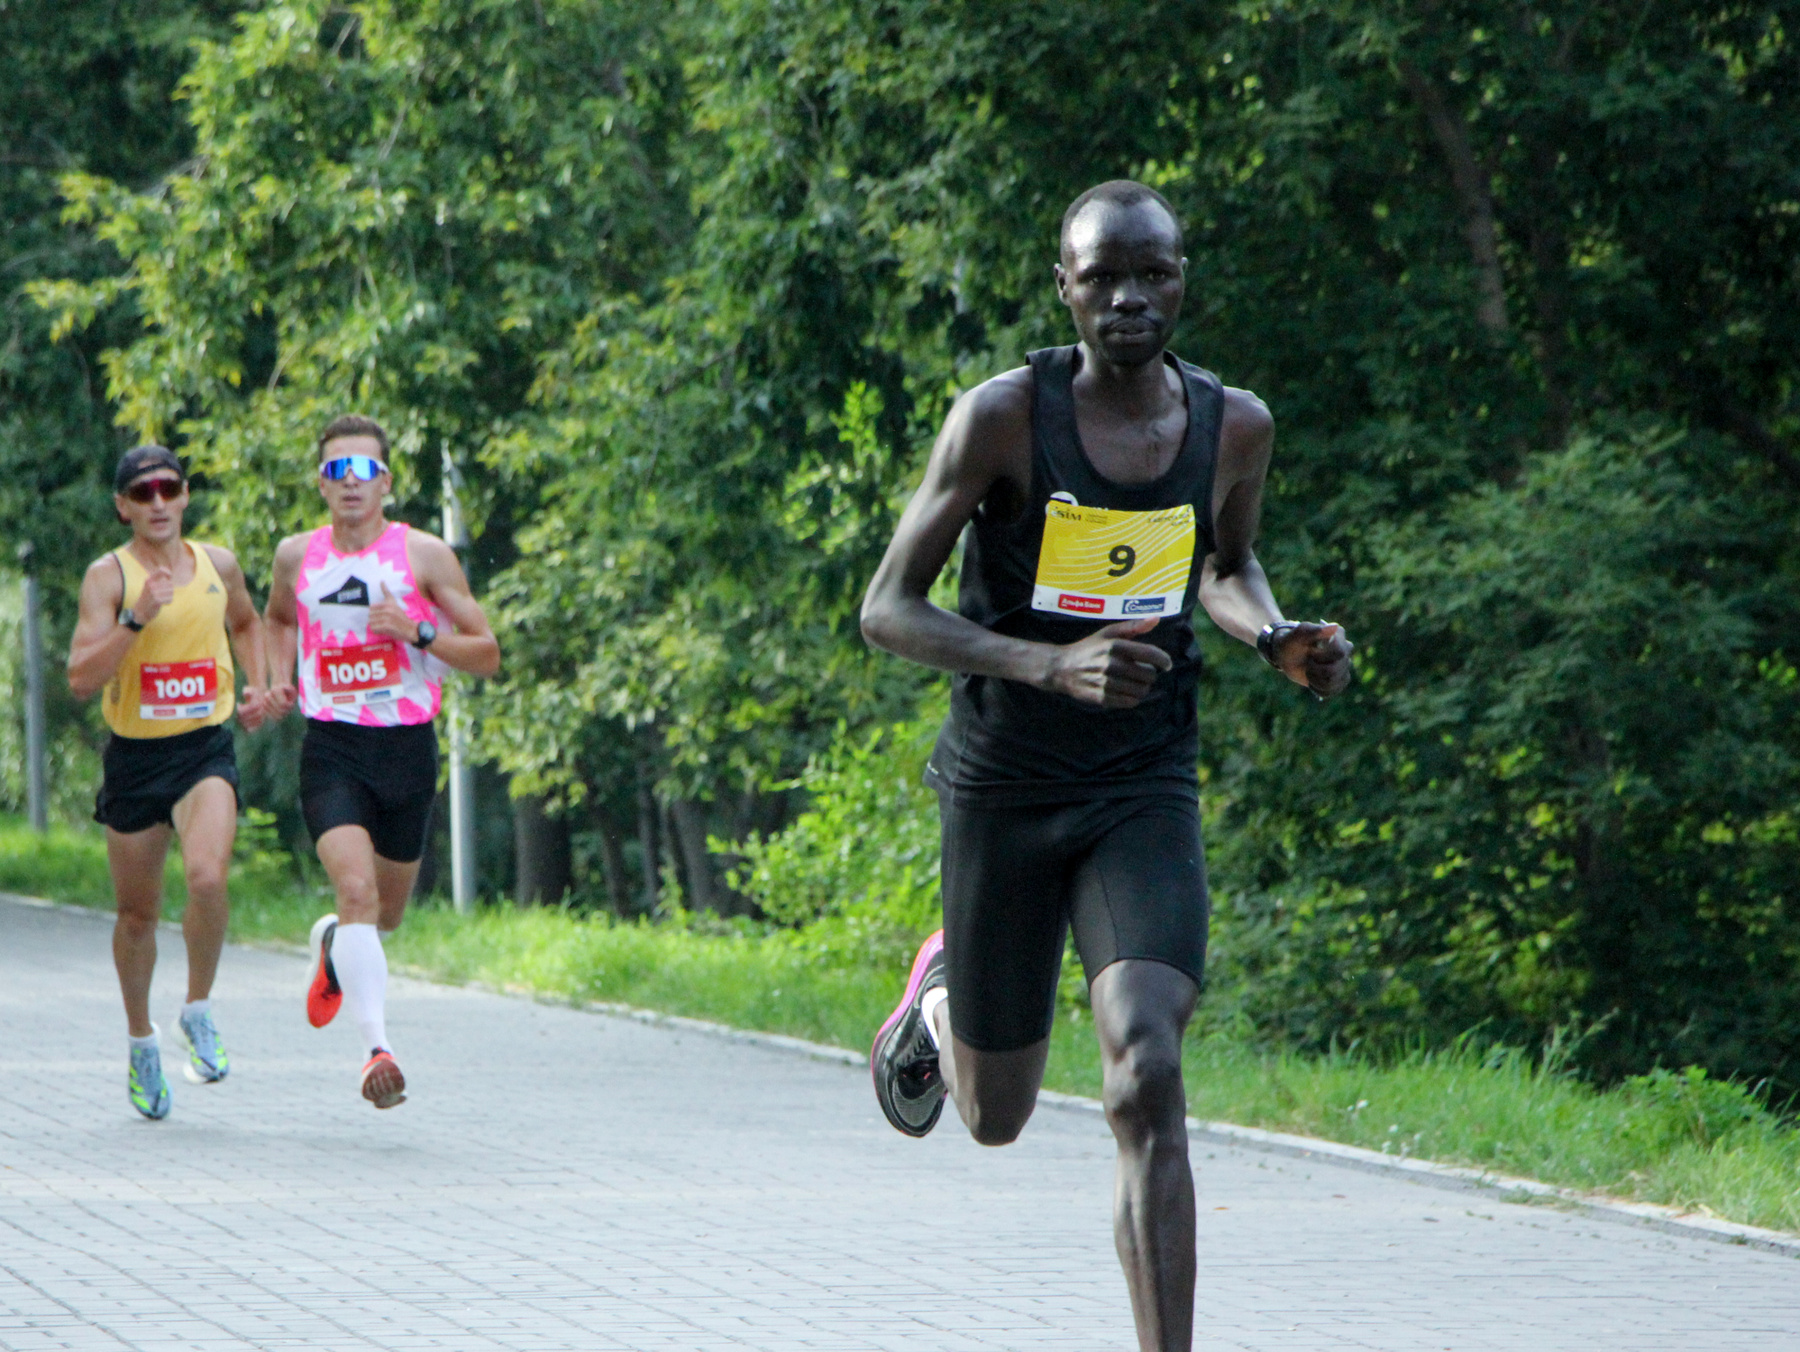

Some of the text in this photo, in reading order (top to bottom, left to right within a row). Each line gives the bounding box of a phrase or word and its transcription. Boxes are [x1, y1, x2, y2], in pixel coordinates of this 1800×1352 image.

[1107, 545, 1136, 577] 9
[327, 658, 387, 685] 1005
[154, 676, 205, 699] 1001
